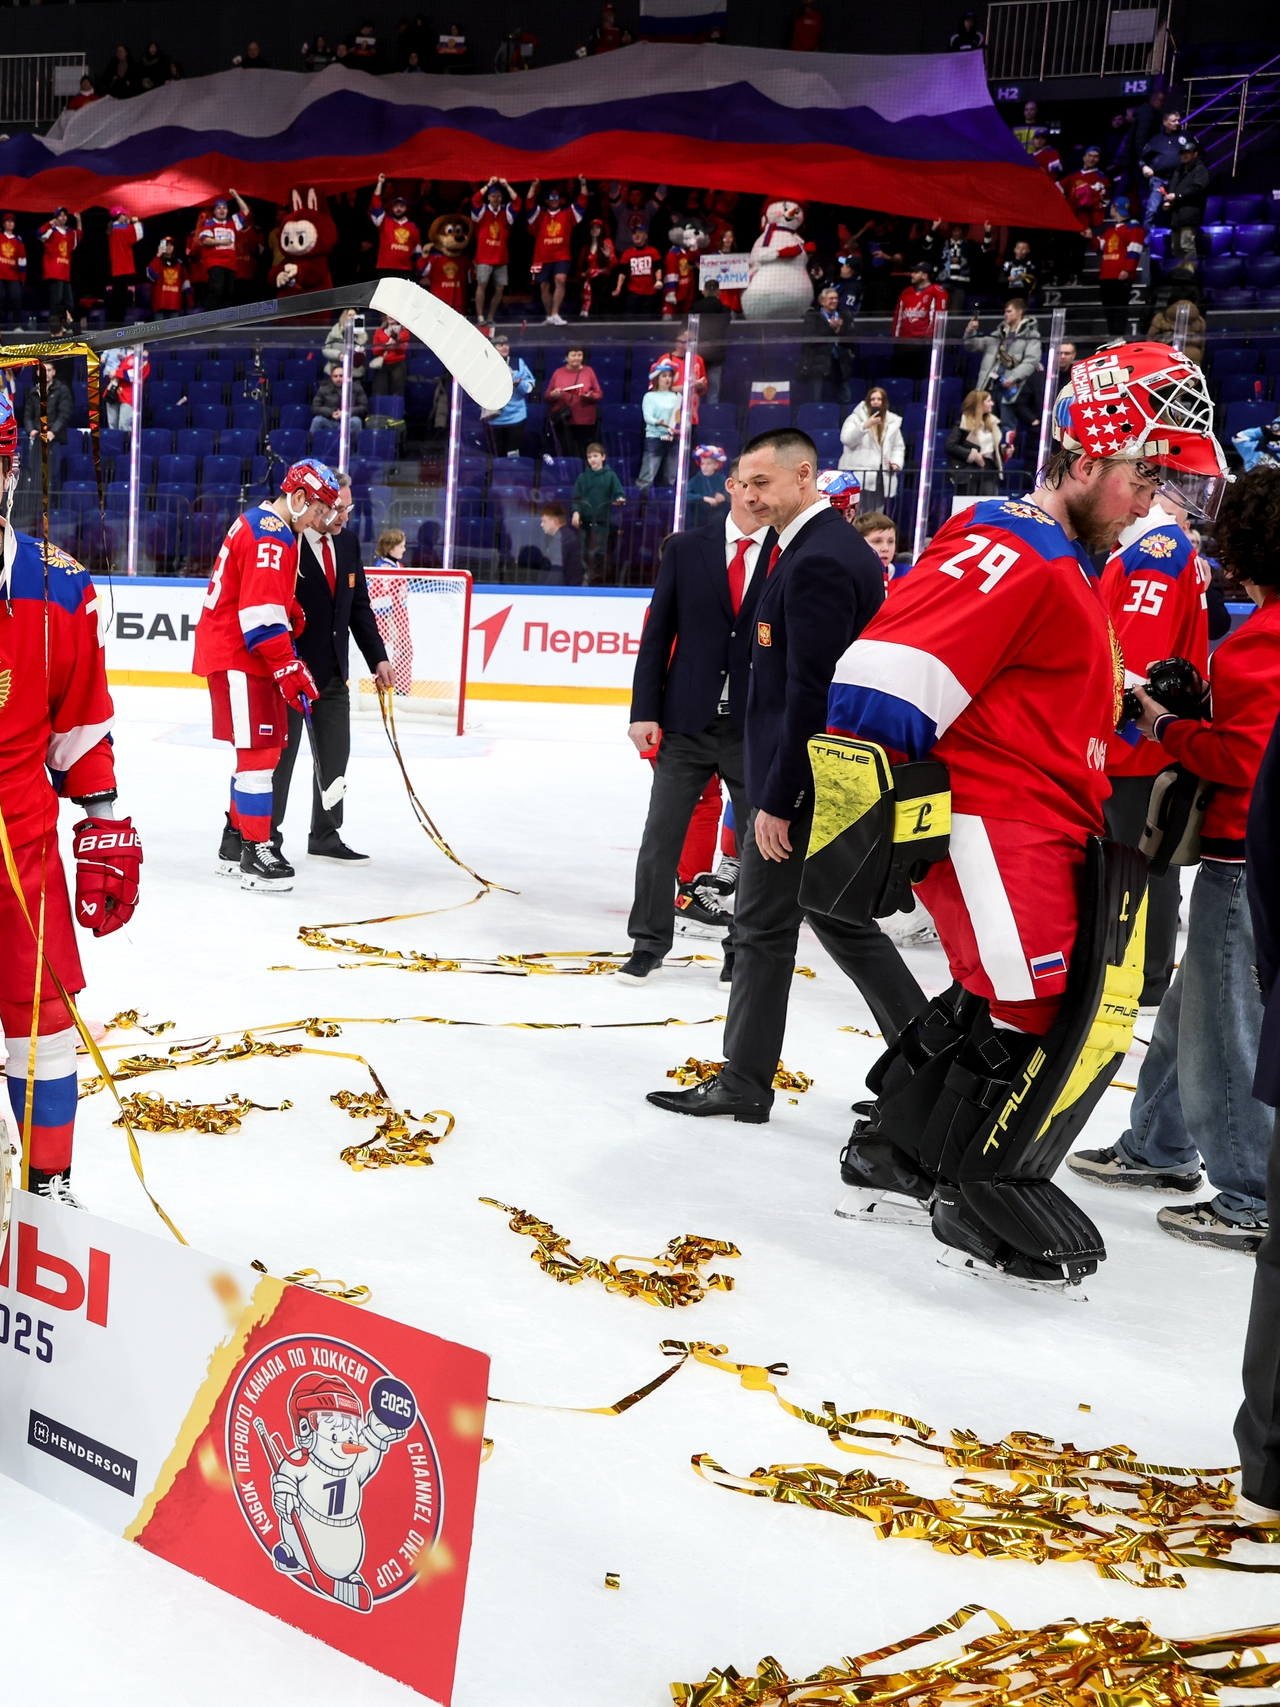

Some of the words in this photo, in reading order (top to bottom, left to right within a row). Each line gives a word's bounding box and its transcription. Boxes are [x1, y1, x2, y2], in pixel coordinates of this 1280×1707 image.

[998, 87, 1019, 100] H2
[1124, 80, 1147, 93] H3
[630, 256, 652, 270] RED
[845, 294, 855, 306] 22
[1045, 291, 1062, 305] 12
[1130, 290, 1142, 303] 2
[1072, 362, 1094, 405] MACHINE
[256, 542, 283, 571] 53
[938, 534, 1021, 595] 29
[204, 543, 230, 611] 3
[1123, 579, 1168, 617] 35
[116, 612, 198, 641] БАН
[811, 745, 871, 765] TRUE
[1102, 1003, 1139, 1019] TRUE
[982, 1046, 1047, 1156] TRUE
[287, 1347, 307, 1367] ПО
[311, 1347, 369, 1385] ХОККЕЮ
[243, 1355, 287, 1404] КАНАЛА
[380, 1390, 412, 1418] 2025
[234, 1403, 253, 1472] ПЕРВОГО
[50, 1432, 131, 1482] HENDERSON
[407, 1441, 432, 1524] CHANNEL
[241, 1481, 274, 1536] КУБОК
[397, 1529, 425, 1567] ONE
[376, 1558, 403, 1589] CUP
